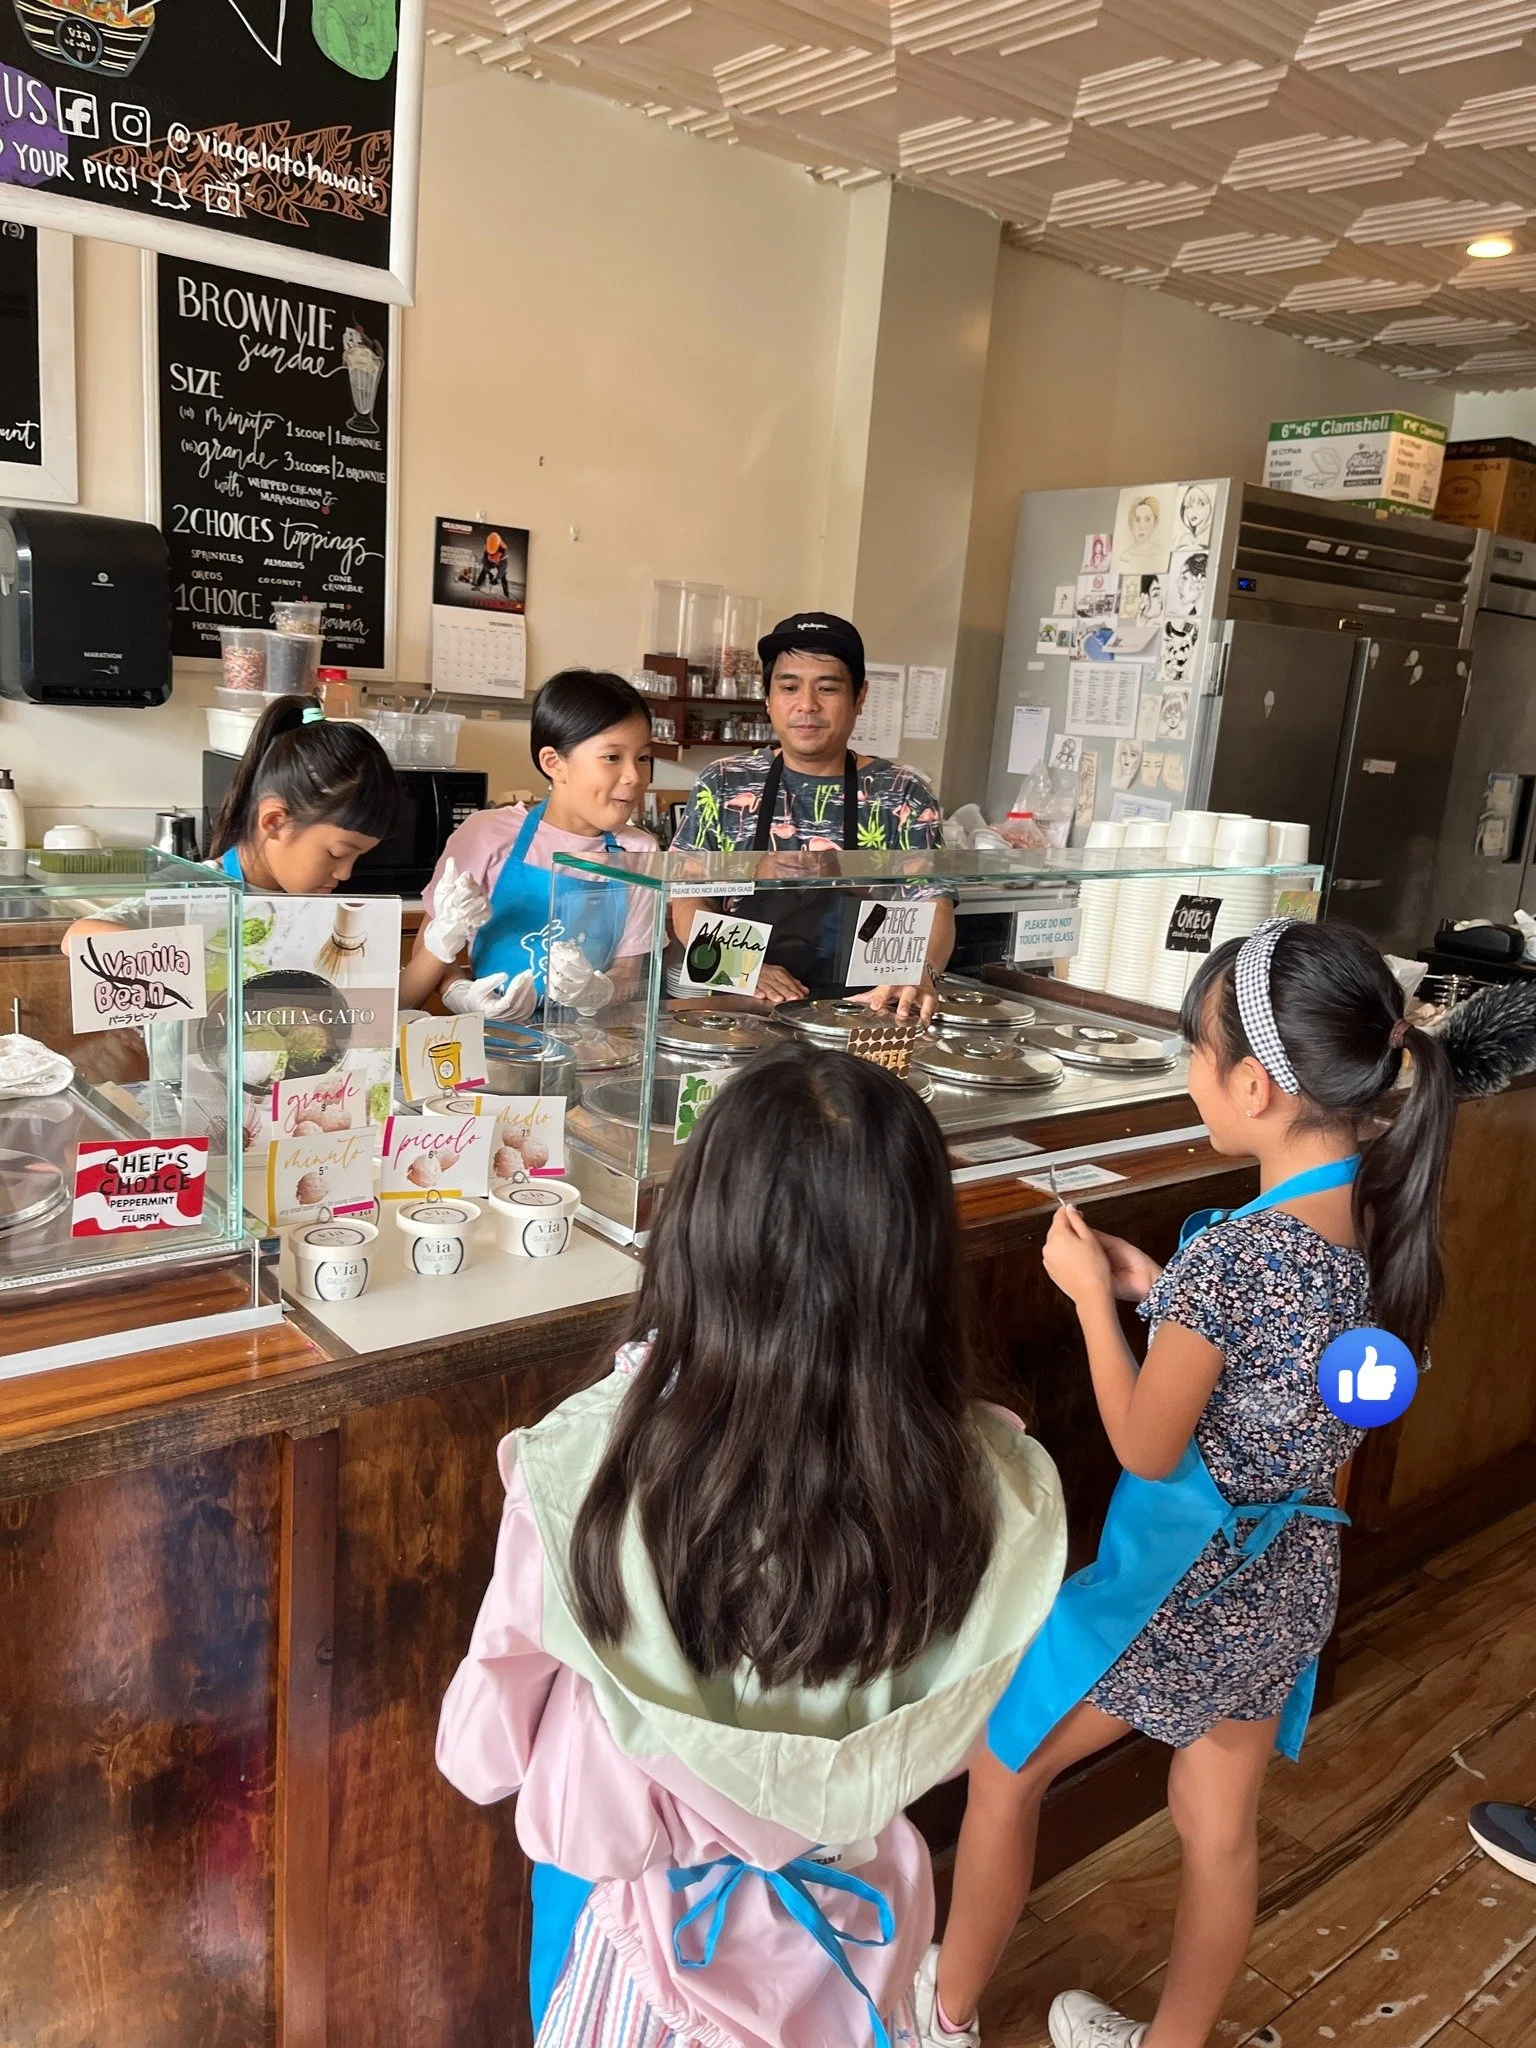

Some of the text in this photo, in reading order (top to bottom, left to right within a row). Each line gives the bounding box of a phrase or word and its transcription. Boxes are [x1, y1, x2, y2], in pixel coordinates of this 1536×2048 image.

[3, 72, 48, 125] US
[12, 141, 75, 181] YOUR
[82, 158, 138, 196] PICS!
[167, 122, 378, 198] @viagelatohawaii
[177, 276, 337, 351] BROWNIE
[169, 362, 224, 399] SIZE
[1320, 414, 1390, 436] Clamshell
[197, 438, 279, 479] grande
[247, 477, 289, 492] WHIPPED
[290, 484, 323, 497] CREAM
[259, 492, 321, 510] MARASCHINO
[190, 549, 245, 564] SPRINKLES
[263, 557, 306, 570] ALMONDS
[191, 570, 223, 581] OREOS
[257, 577, 303, 588] COCONUT
[328, 574, 353, 584] CONE
[321, 583, 364, 594] CRUMBLE
[83, 651, 123, 660] MARATHON
[882, 906, 919, 935] FIERCE
[1024, 917, 1073, 930] PLEASE DO NOT
[1177, 909, 1212, 930] OREO
[694, 919, 766, 952] Matcha
[1019, 931, 1074, 945] TOUCH THE GLASS
[864, 936, 926, 965] CHOCOLATE
[102, 942, 191, 980] Vanilla
[94, 981, 165, 1014] Bean
[284, 1073, 360, 1133] grande
[496, 1099, 553, 1138] medio
[393, 1116, 482, 1170] piccolo
[104, 1151, 189, 1175] CHEF'S
[99, 1173, 191, 1196] CHOICE
[110, 1196, 175, 1208] PEPPERMINT
[121, 1212, 160, 1223] FLURRY
[538, 1220, 561, 1234] via
[421, 1253, 455, 1262] GELATO
[425, 1241, 451, 1254] via
[332, 1262, 358, 1276] via
[326, 1275, 361, 1285] GELATO
